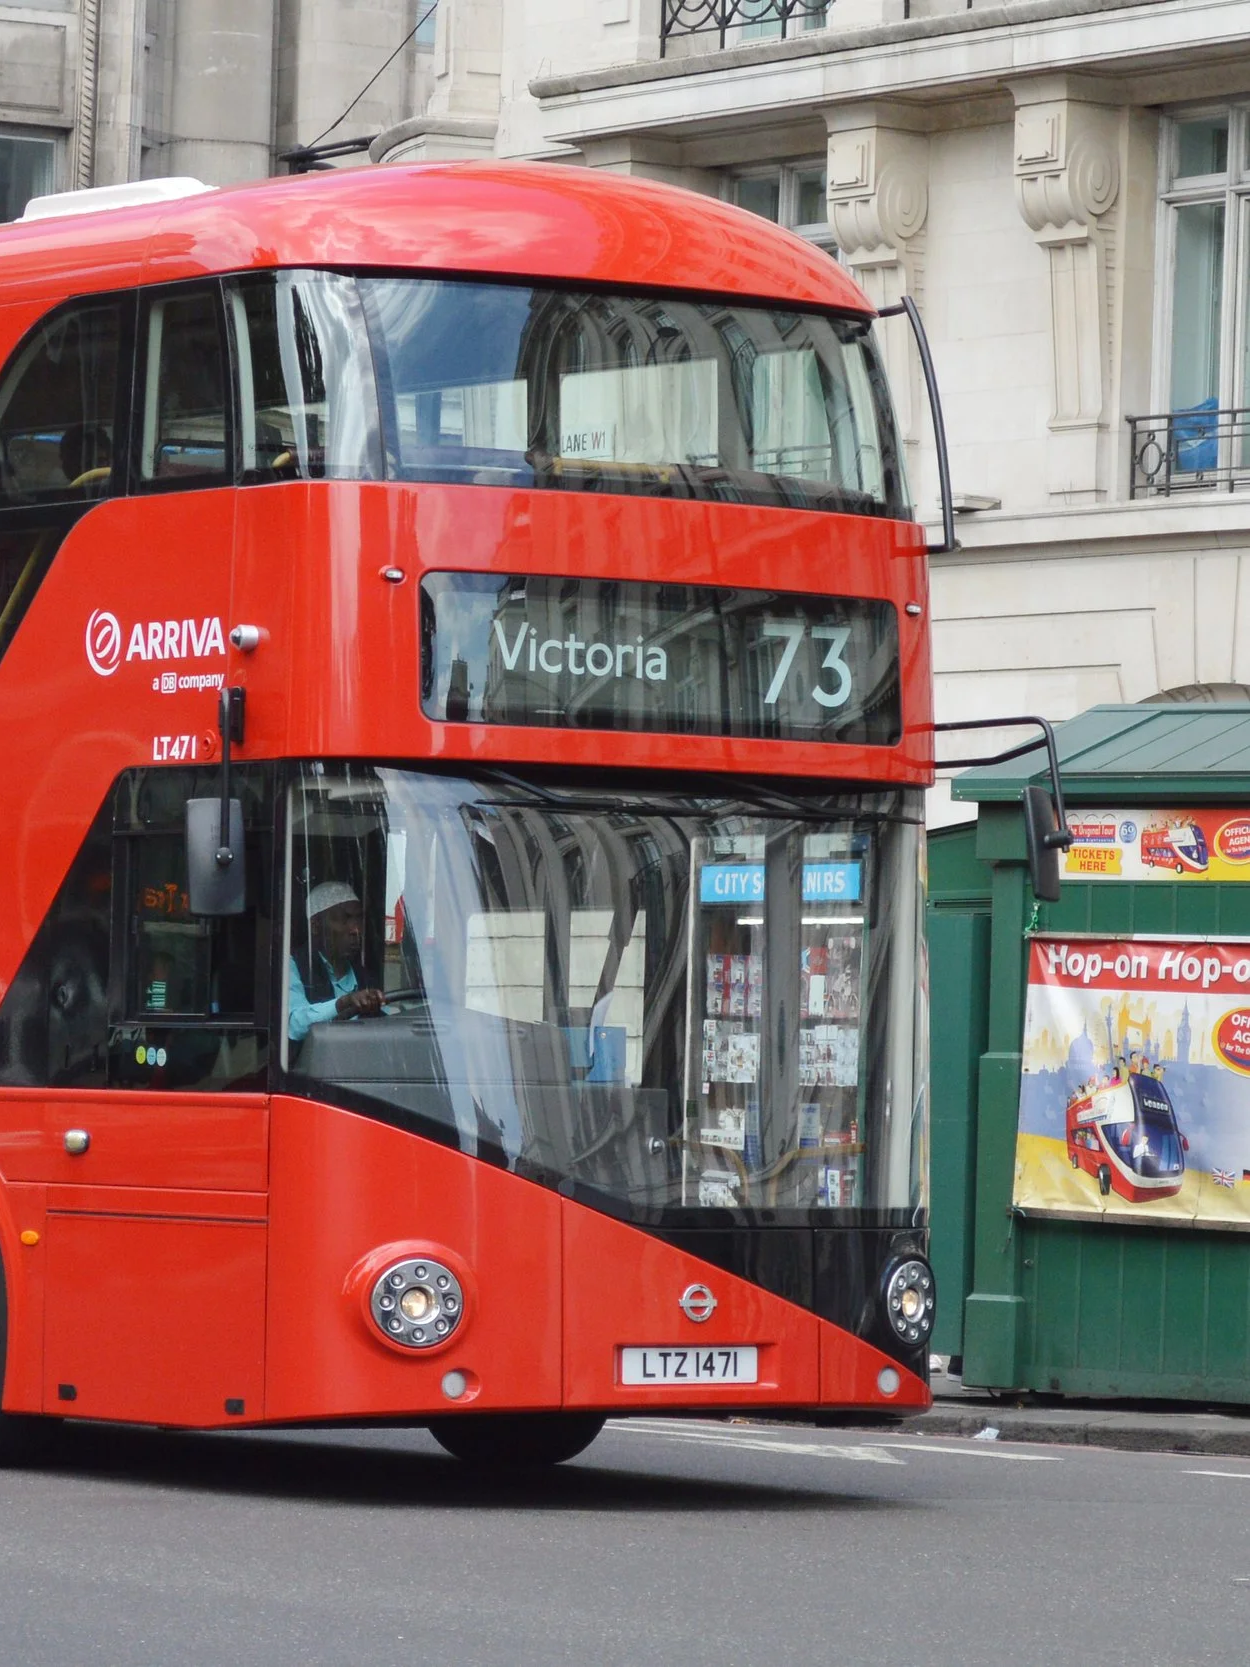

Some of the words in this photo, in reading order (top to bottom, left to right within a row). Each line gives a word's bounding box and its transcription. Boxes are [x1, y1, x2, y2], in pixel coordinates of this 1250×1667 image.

[561, 433, 587, 453] LANE
[591, 431, 606, 450] W1
[125, 616, 226, 661] ARRIVA
[493, 619, 668, 681] Victoria
[762, 623, 852, 708] 73
[152, 677, 159, 690] a
[162, 675, 175, 691] DB
[178, 673, 225, 692] company
[152, 735, 197, 761] LT471
[1072, 848, 1116, 860] TICKETS
[1079, 860, 1107, 872] HERE
[714, 872, 749, 895] CITY
[1047, 944, 1149, 984] Hop-on
